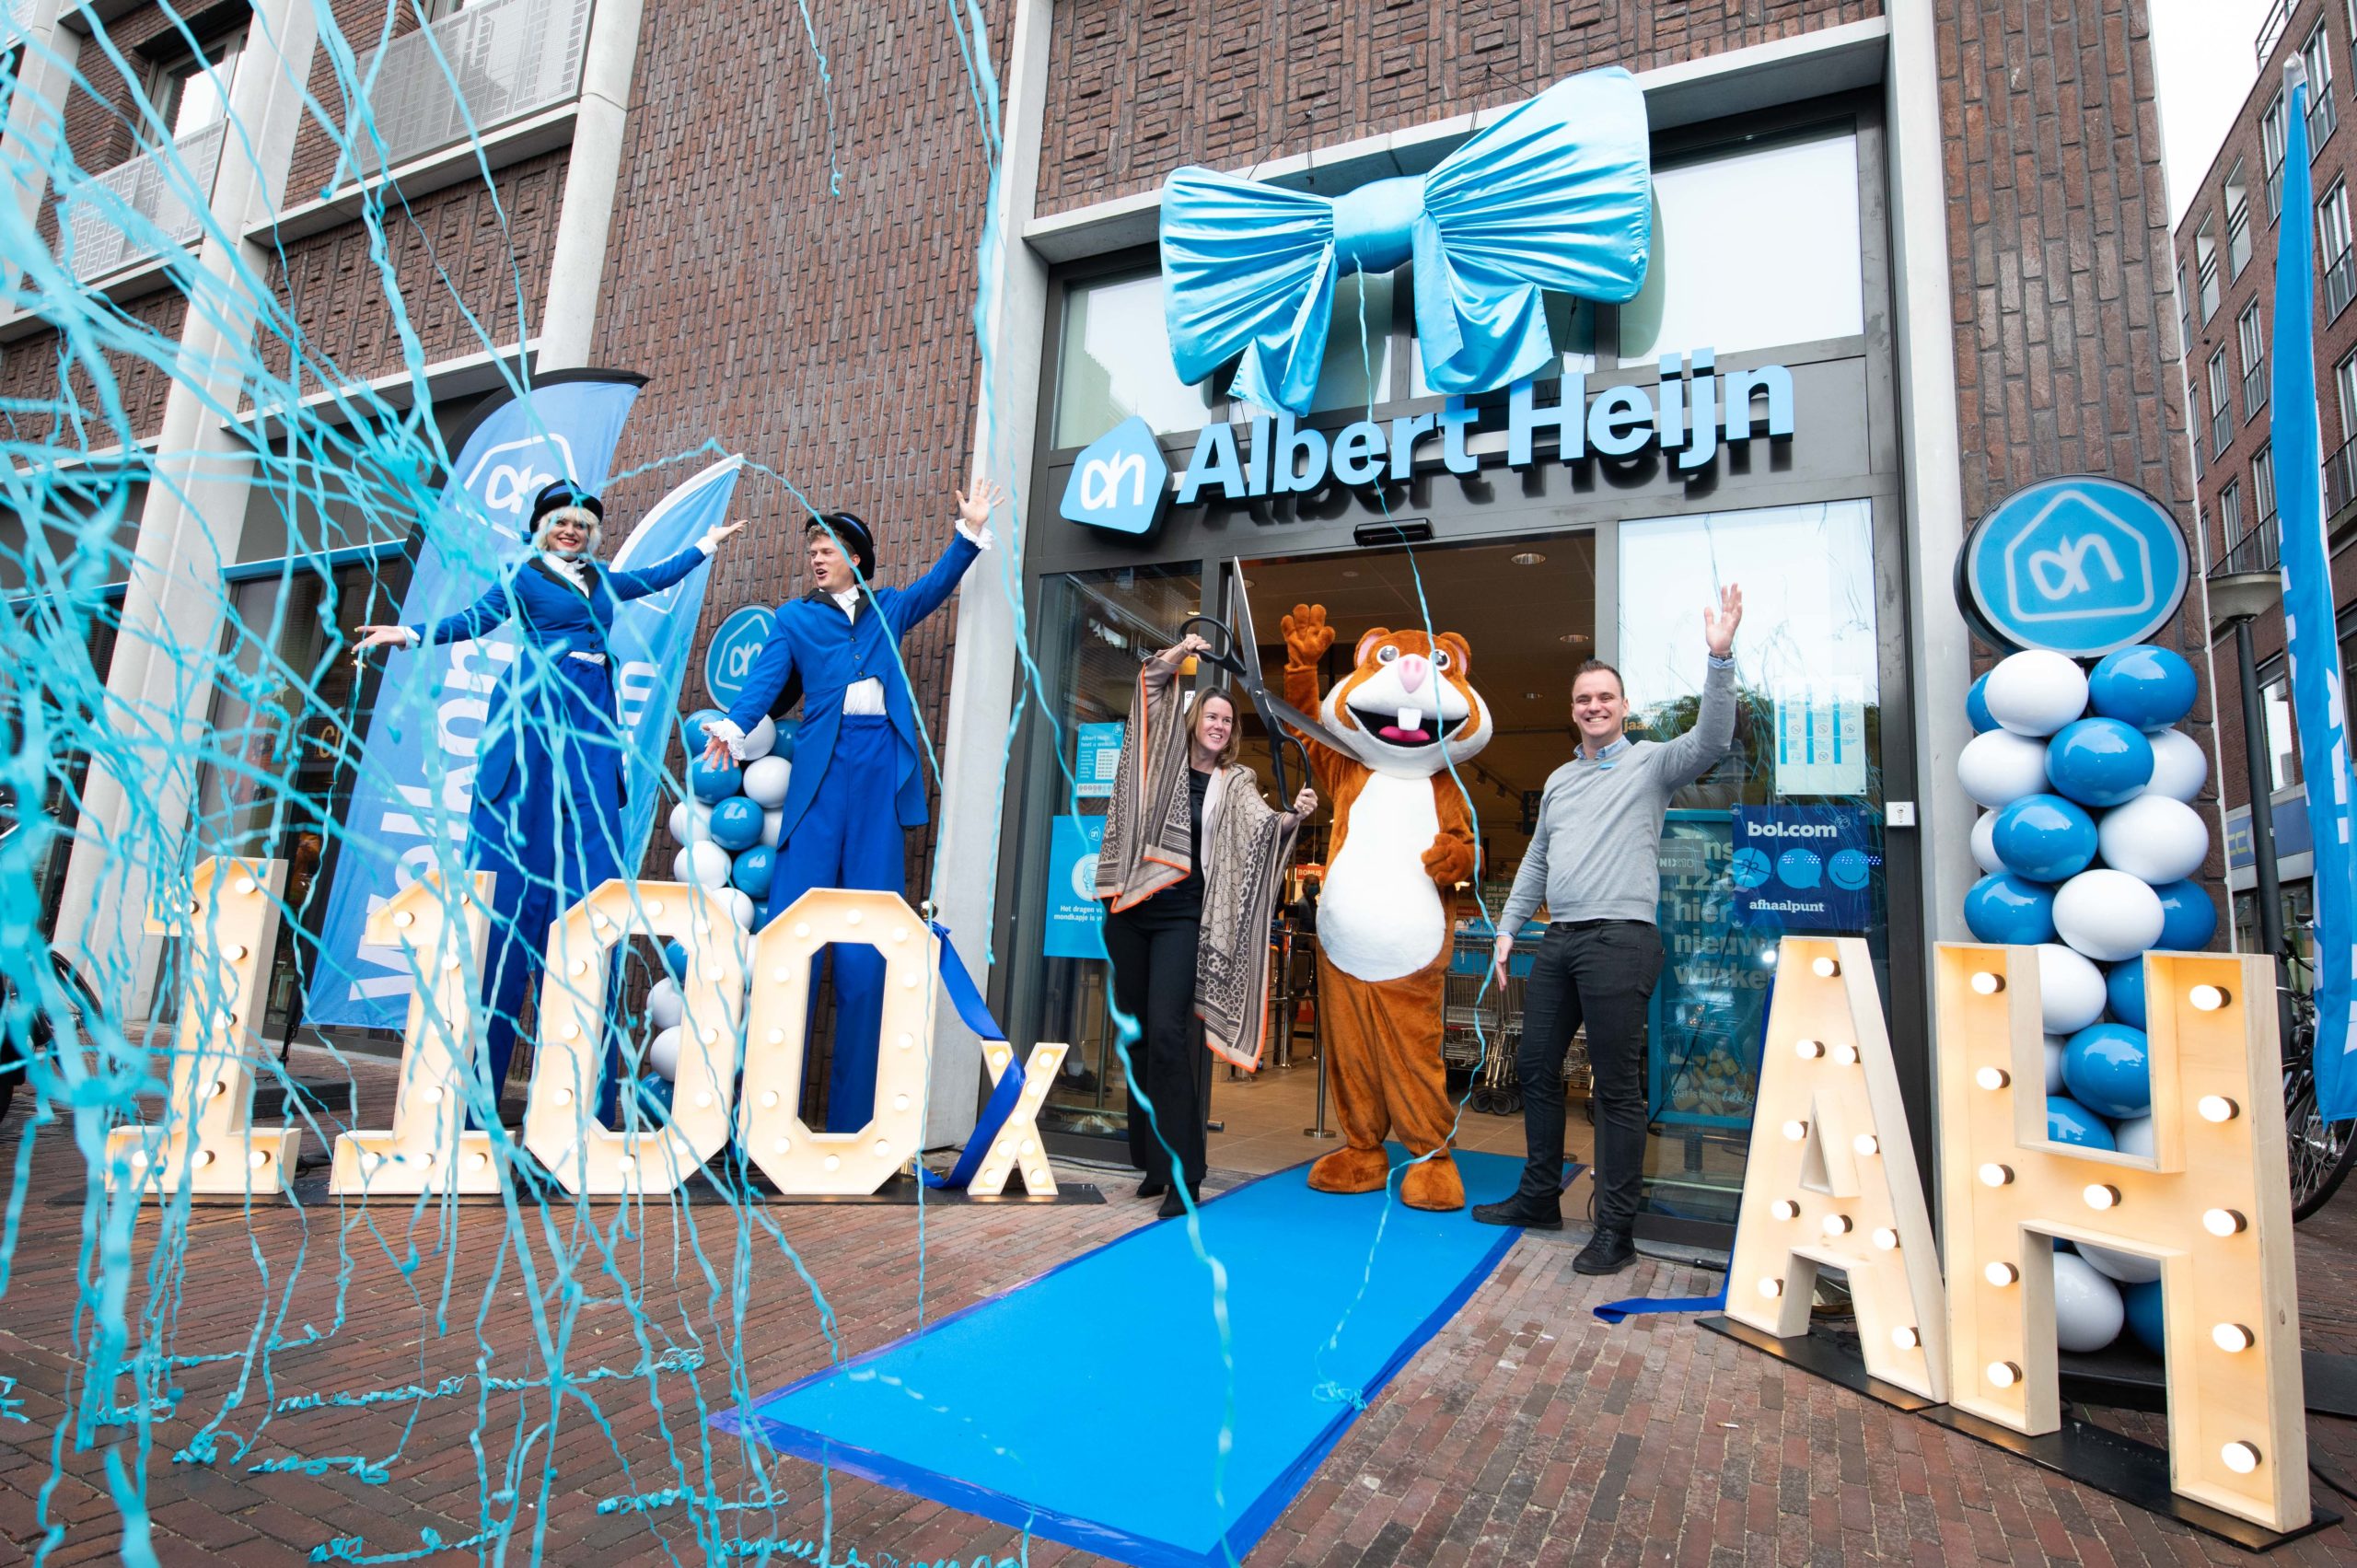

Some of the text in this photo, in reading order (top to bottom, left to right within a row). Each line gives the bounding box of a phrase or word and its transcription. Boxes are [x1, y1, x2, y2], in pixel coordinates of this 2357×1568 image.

[1177, 346, 1795, 505] Albert Heijn
[1747, 821, 1838, 838] bol.com
[1297, 868, 1322, 877] BONUS
[1073, 905, 1095, 914] dragen
[1748, 899, 1825, 913] afhaalpunt
[1053, 913, 1088, 923] mondkapje
[1724, 935, 2313, 1534] AH
